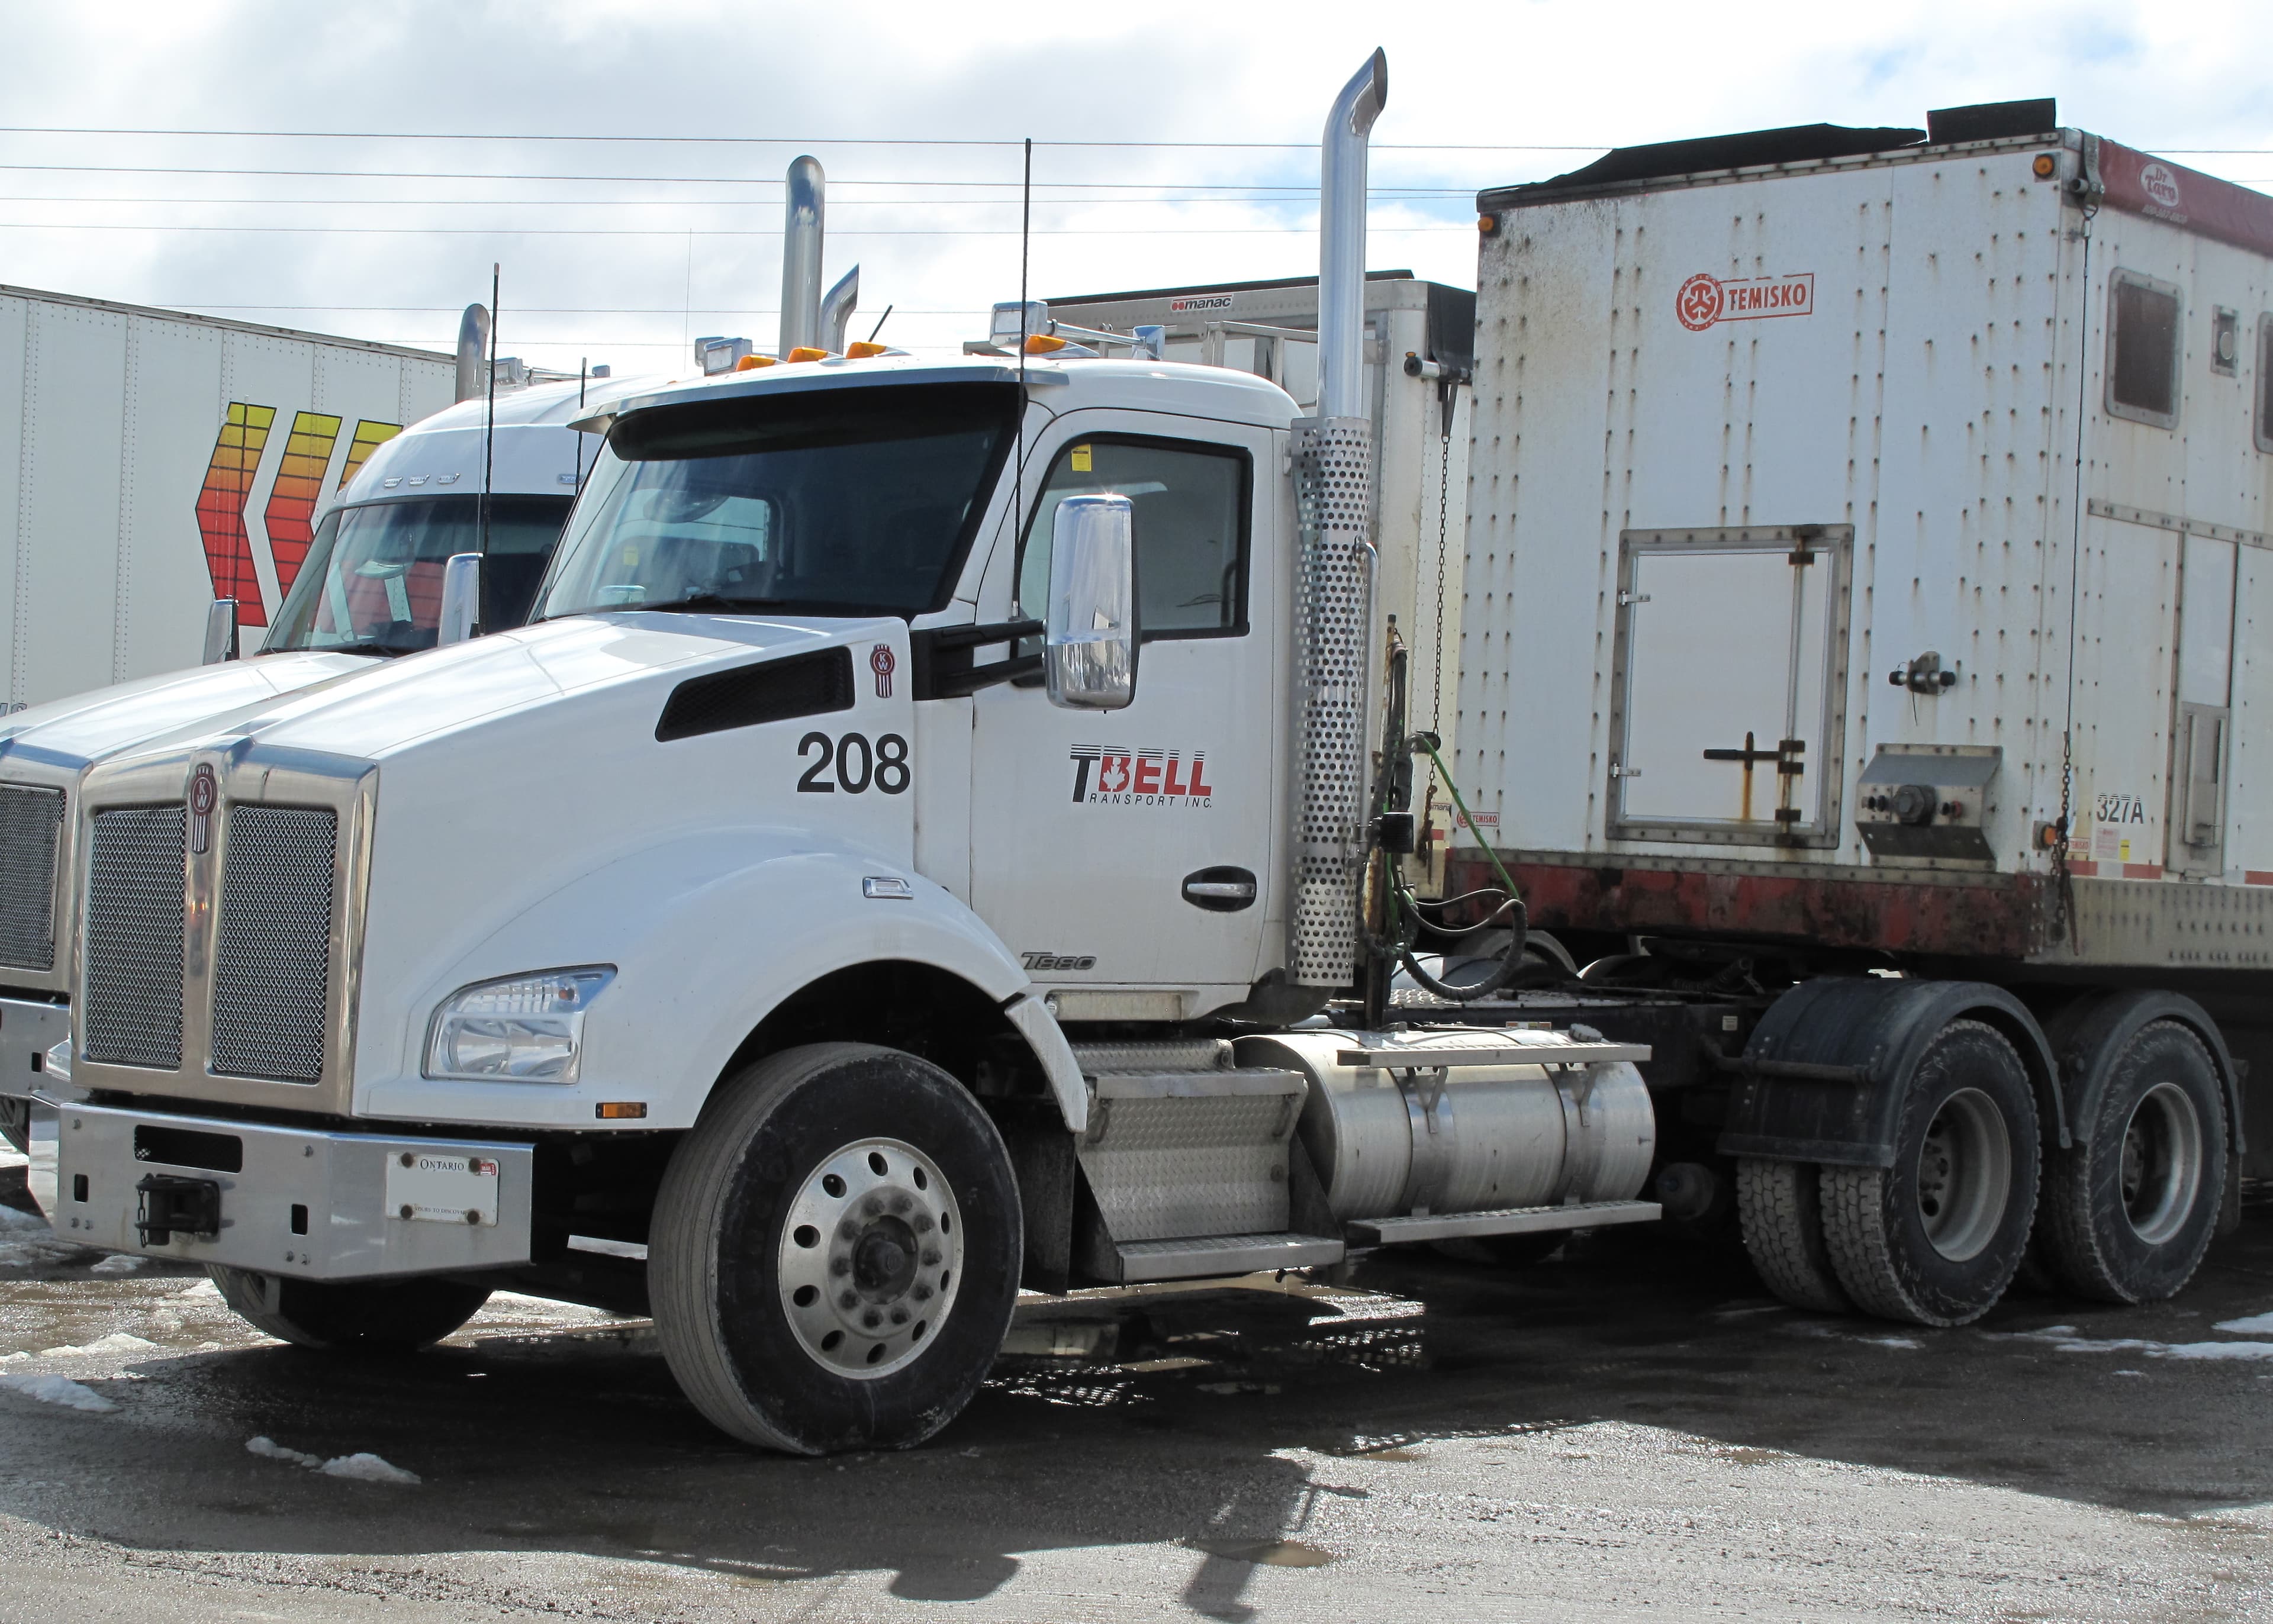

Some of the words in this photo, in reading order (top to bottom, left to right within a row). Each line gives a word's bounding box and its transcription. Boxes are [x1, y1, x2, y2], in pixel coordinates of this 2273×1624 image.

[2155, 167, 2167, 182] Dr
[1184, 298, 1231, 310] manac
[1728, 283, 1807, 311] TEMISKO
[797, 732, 910, 794] 208
[1185, 797, 1212, 808] INC.
[2097, 792, 2143, 824] 327A
[1472, 815, 1497, 823] TEMISKO
[1021, 952, 1097, 970] T880
[420, 1159, 464, 1171] ONTARIO
